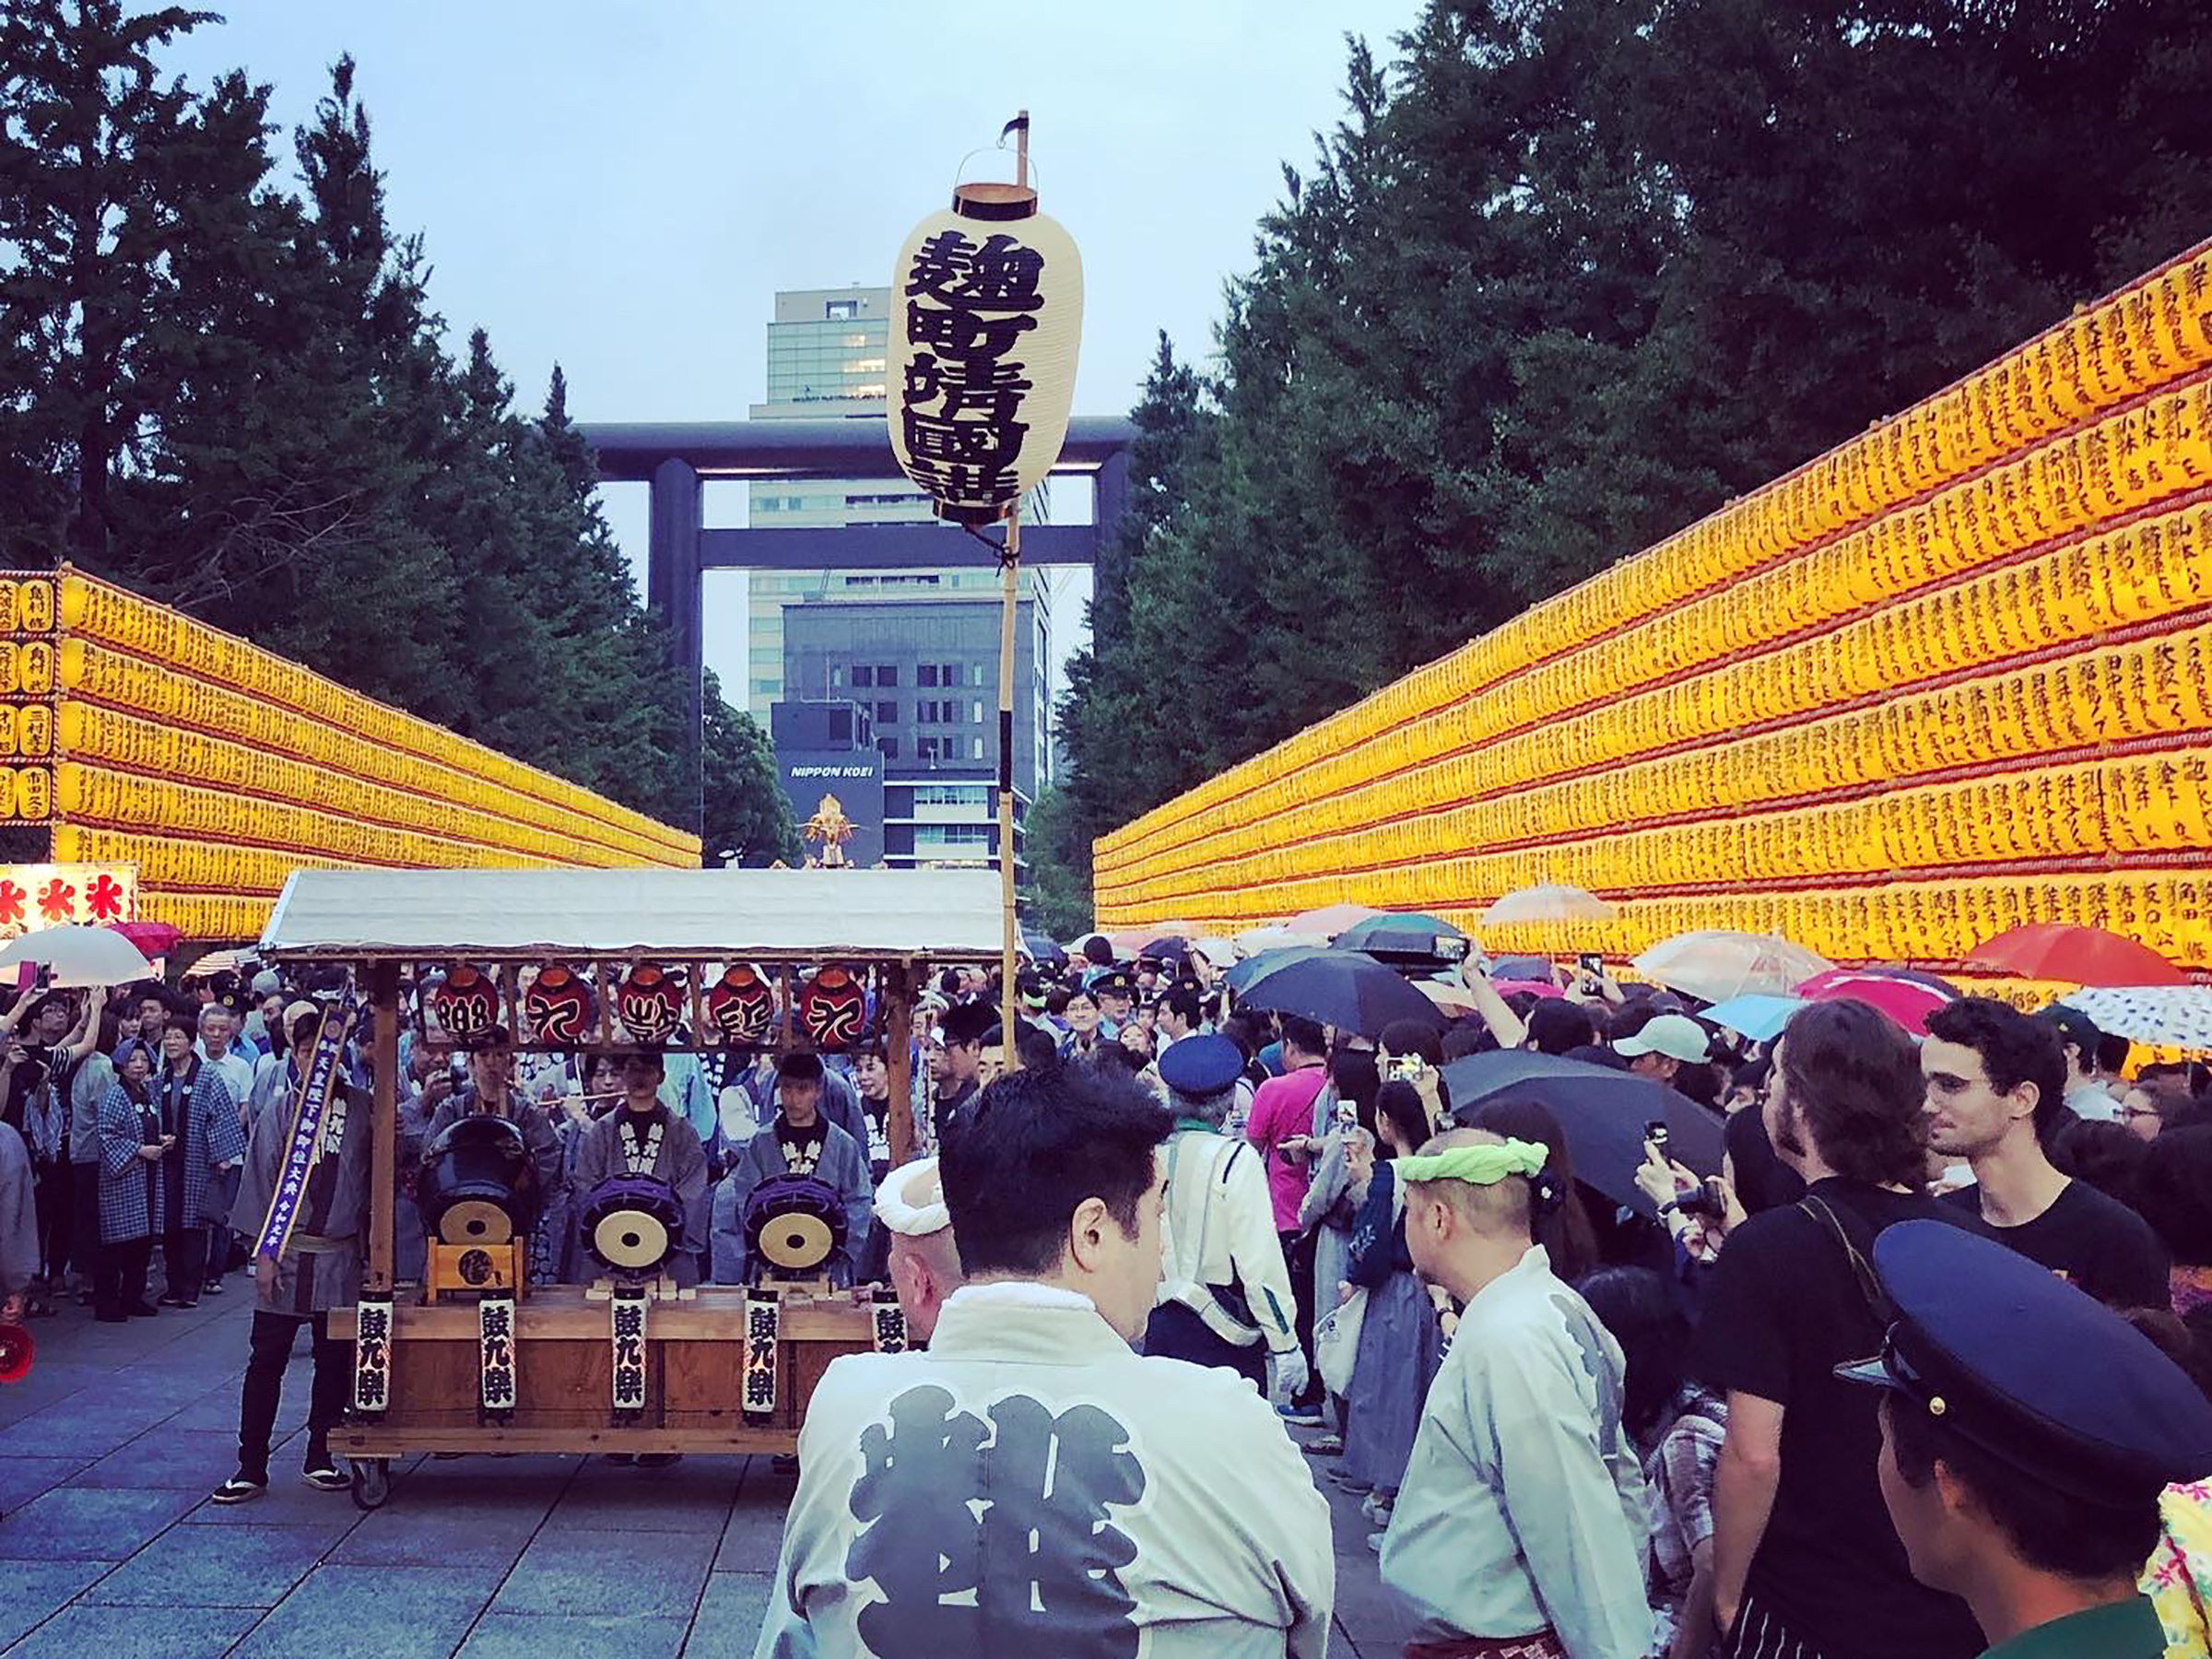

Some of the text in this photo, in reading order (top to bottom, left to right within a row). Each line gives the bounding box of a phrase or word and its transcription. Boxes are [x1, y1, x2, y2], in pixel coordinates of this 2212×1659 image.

[790, 766, 874, 778] NIPPON KOEI
[37, 878, 76, 922] 氷
[85, 874, 123, 919] 氷
